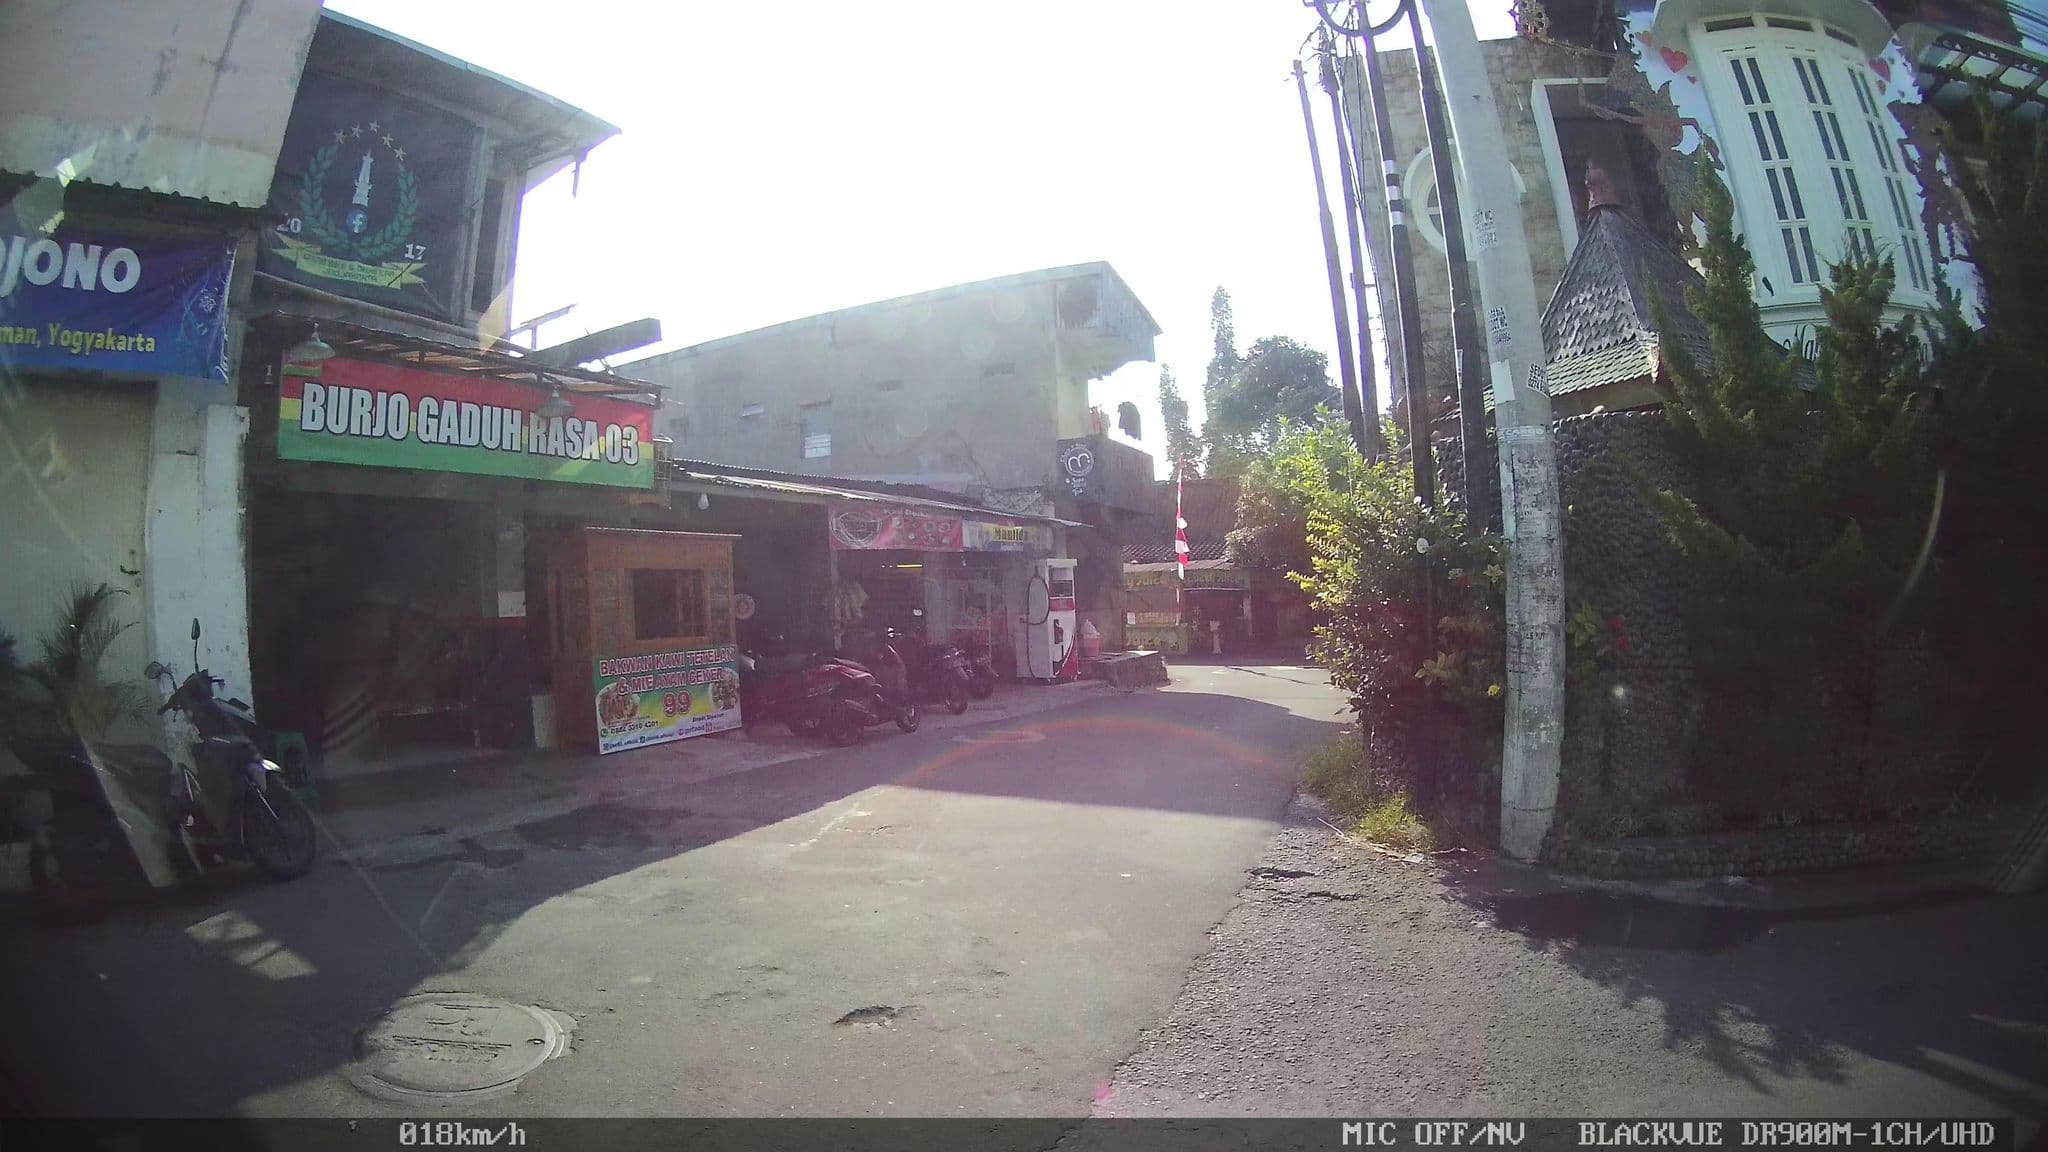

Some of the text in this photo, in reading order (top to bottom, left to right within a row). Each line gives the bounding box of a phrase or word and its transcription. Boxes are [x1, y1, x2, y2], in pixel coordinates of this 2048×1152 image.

[404, 243, 427, 260] 17
[0, 235, 141, 298] JONO
[48, 323, 155, 355] Yogyakarta
[300, 382, 640, 466] BURJO GADUH RASA 03
[600, 655, 653, 677] BAKWAN
[654, 652, 685, 669] KAWI
[617, 677, 628, 695] &
[631, 675, 653, 693] MIE
[655, 671, 687, 689] AYAM
[664, 691, 691, 717] 99
